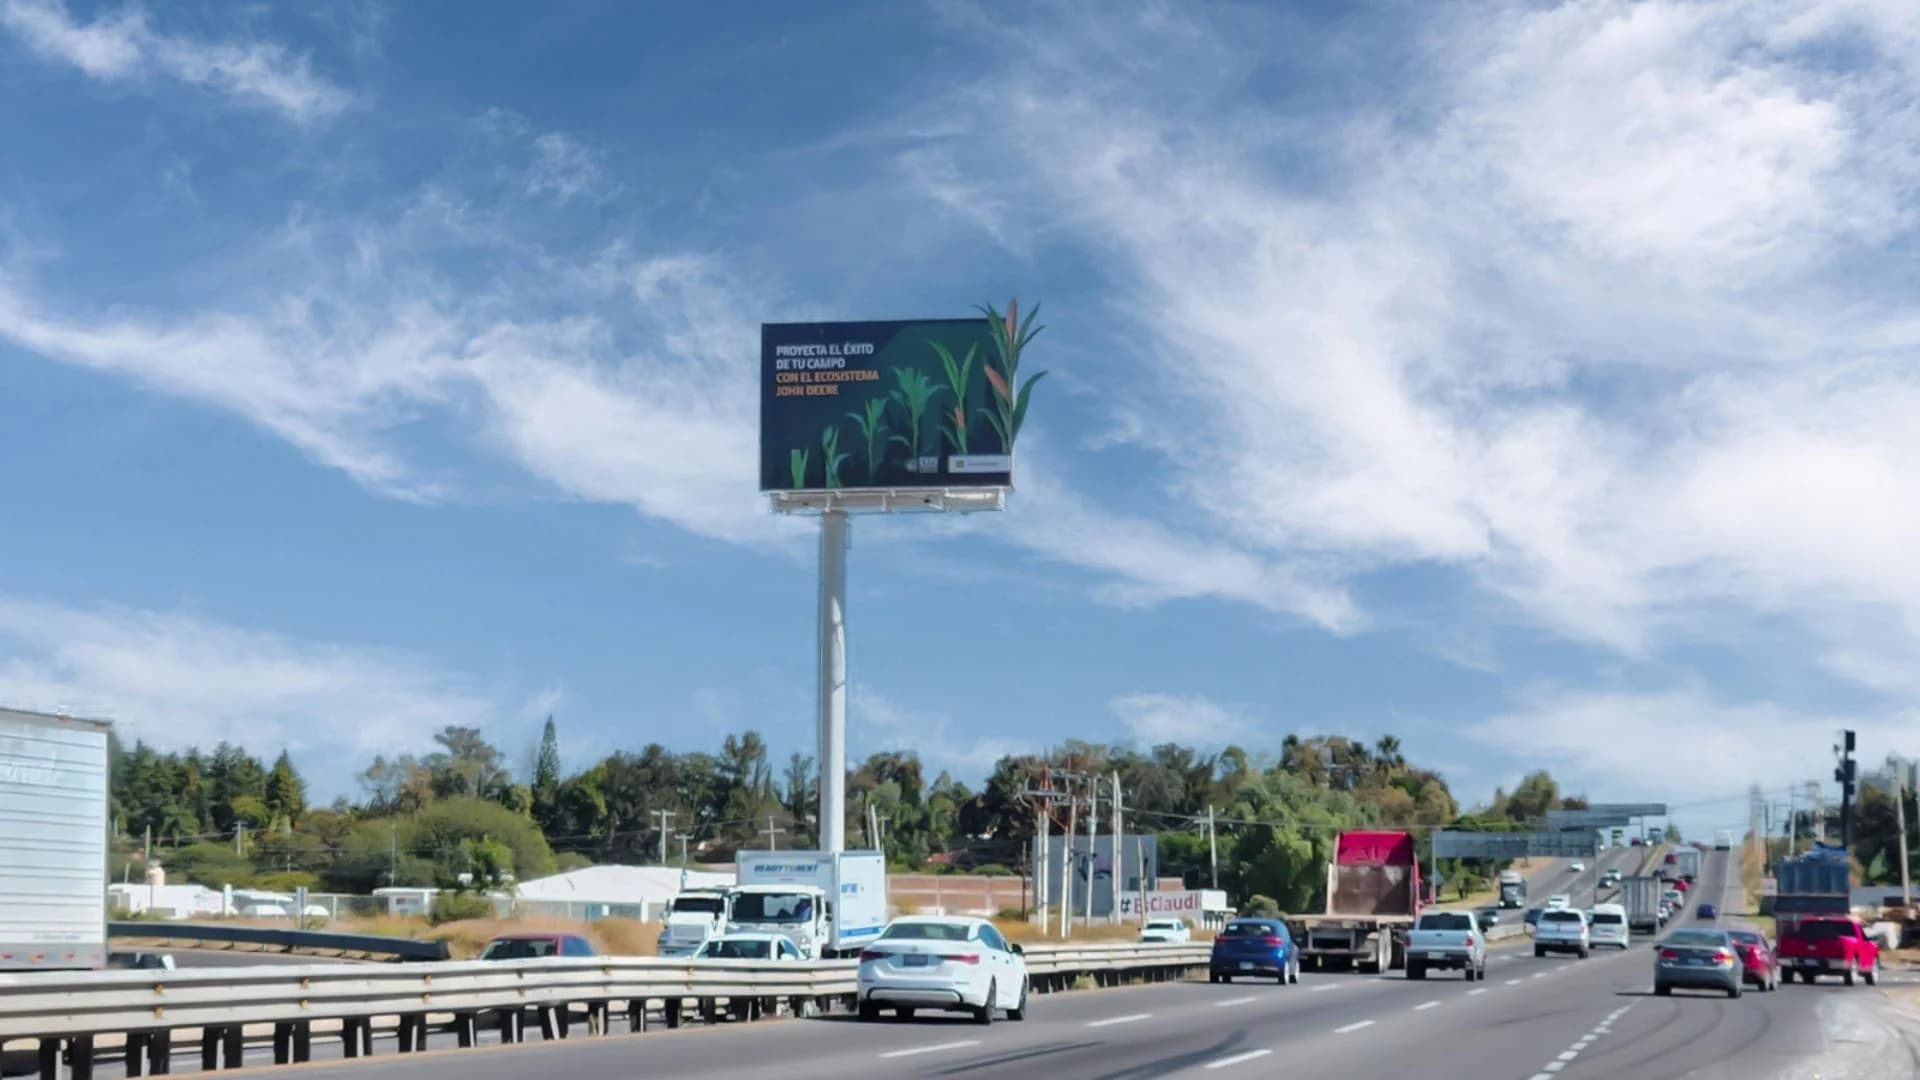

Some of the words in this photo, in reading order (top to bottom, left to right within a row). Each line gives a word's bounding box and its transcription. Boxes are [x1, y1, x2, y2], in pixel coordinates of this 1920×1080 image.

[776, 345, 828, 356] PROYECTA
[829, 344, 842, 355] EL
[844, 341, 874, 354] ÉXITO
[776, 359, 790, 369] DE
[792, 358, 806, 369] TU
[807, 357, 846, 369] CAMPO
[776, 372, 799, 383] CON
[800, 372, 813, 382] EL
[814, 370, 880, 382] ECOSISTEMA
[776, 386, 804, 397] JOHN
[805, 384, 839, 395] DEERE
